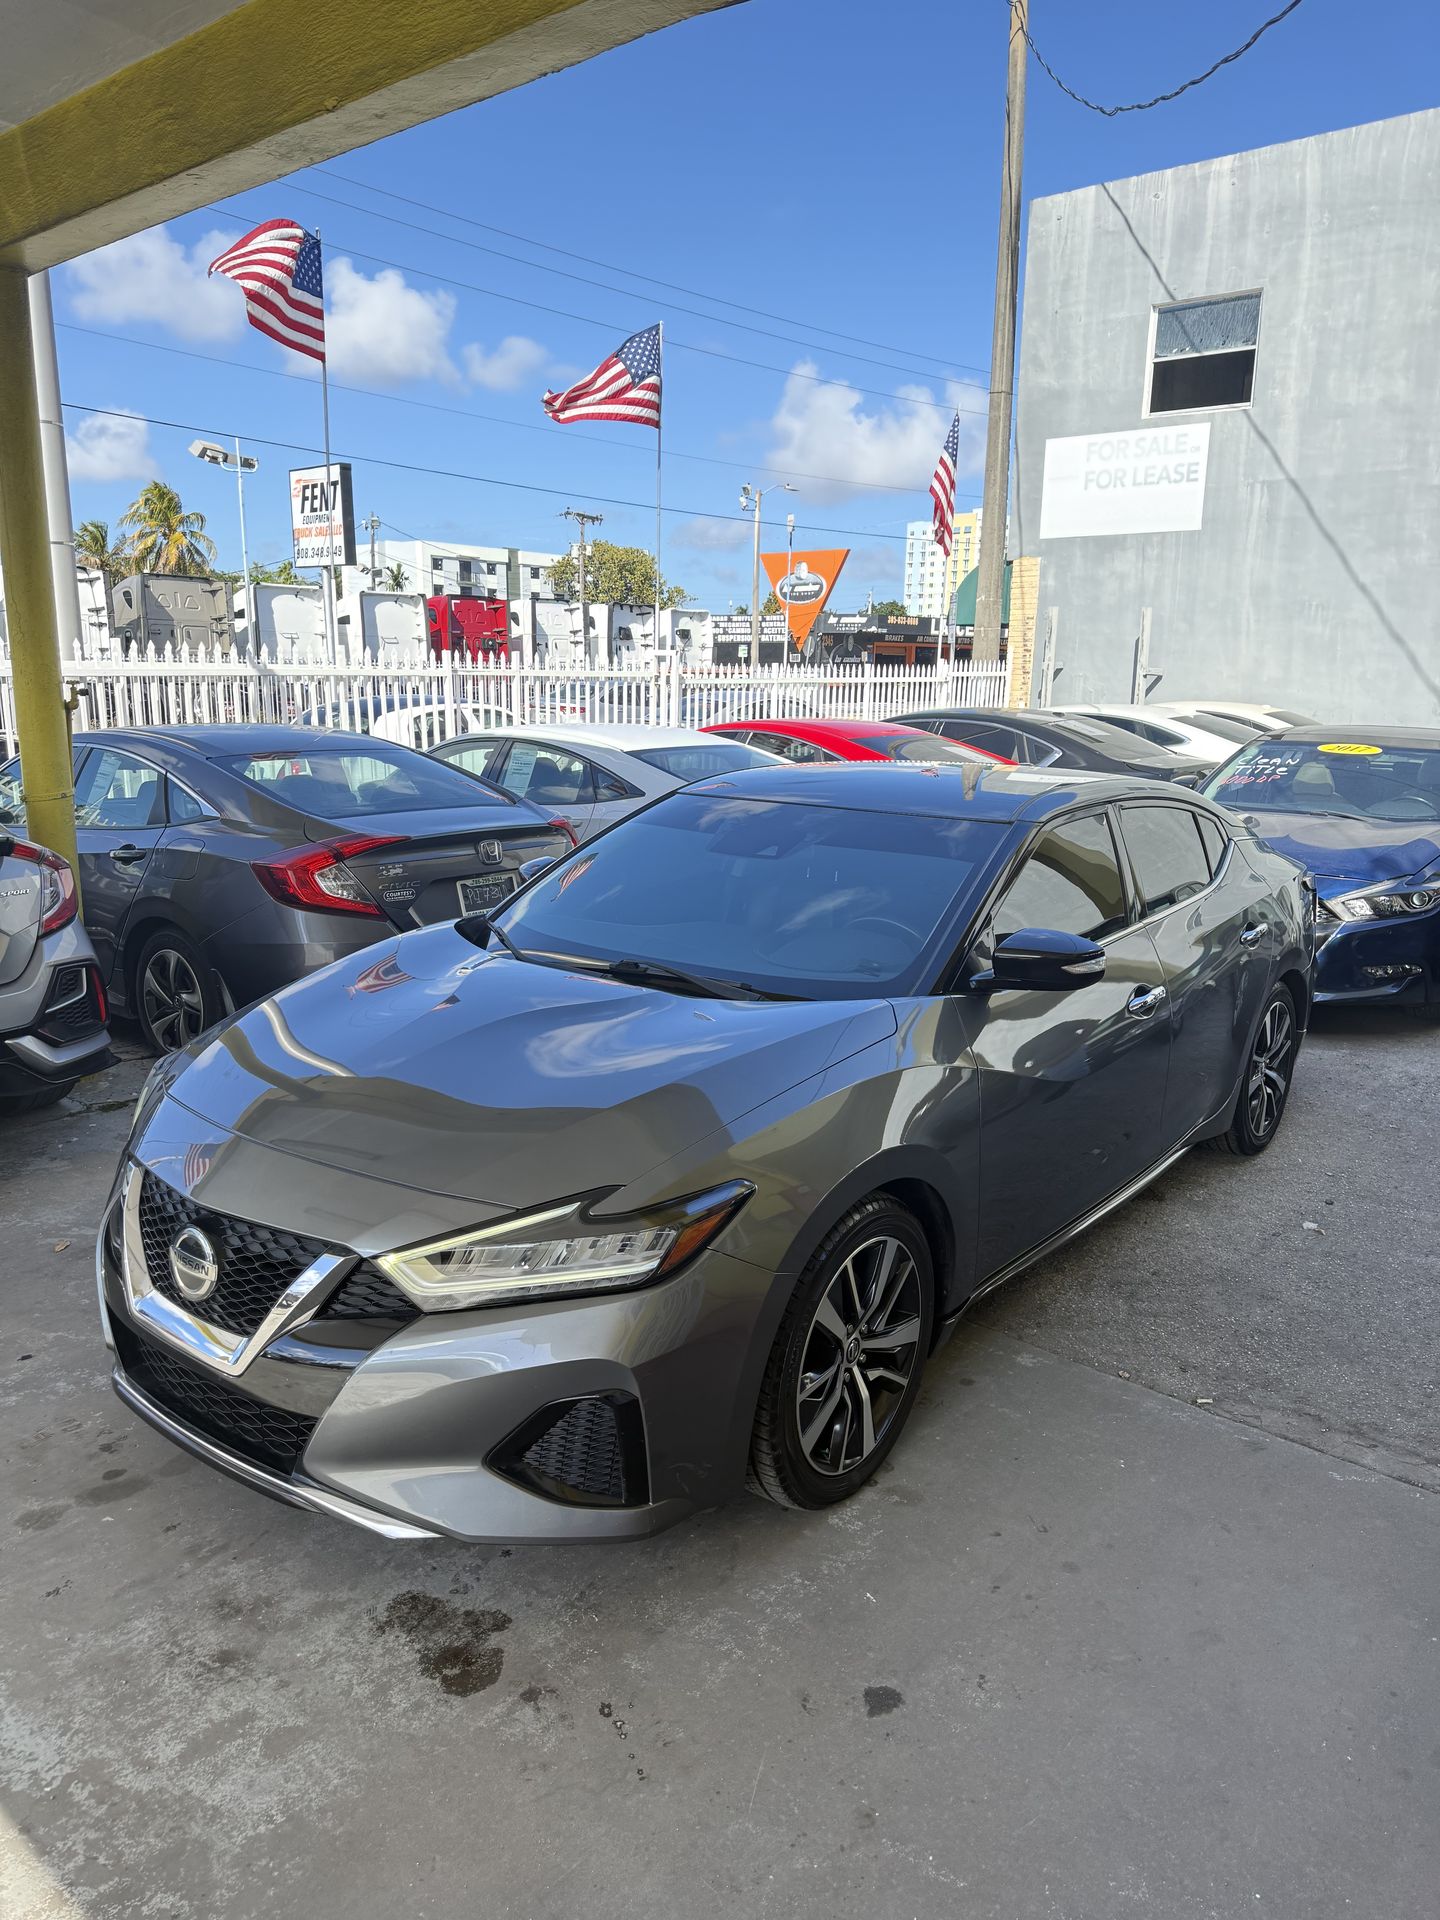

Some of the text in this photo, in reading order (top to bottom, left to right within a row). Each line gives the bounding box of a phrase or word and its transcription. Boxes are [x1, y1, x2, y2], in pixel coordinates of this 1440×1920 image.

[1086, 439, 1129, 463] FOR
[1133, 433, 1189, 459] SALE
[1083, 462, 1200, 491] FOR LEASE
[300, 480, 339, 513] FENT
[302, 513, 331, 524] EQUIPMEN
[717, 634, 754, 642] SUSPENSIO
[884, 634, 904, 642] BRAKES
[378, 881, 421, 889] CIVIC
[0, 888, 30, 897] SPORT
[174, 1248, 210, 1277] NISSAN
